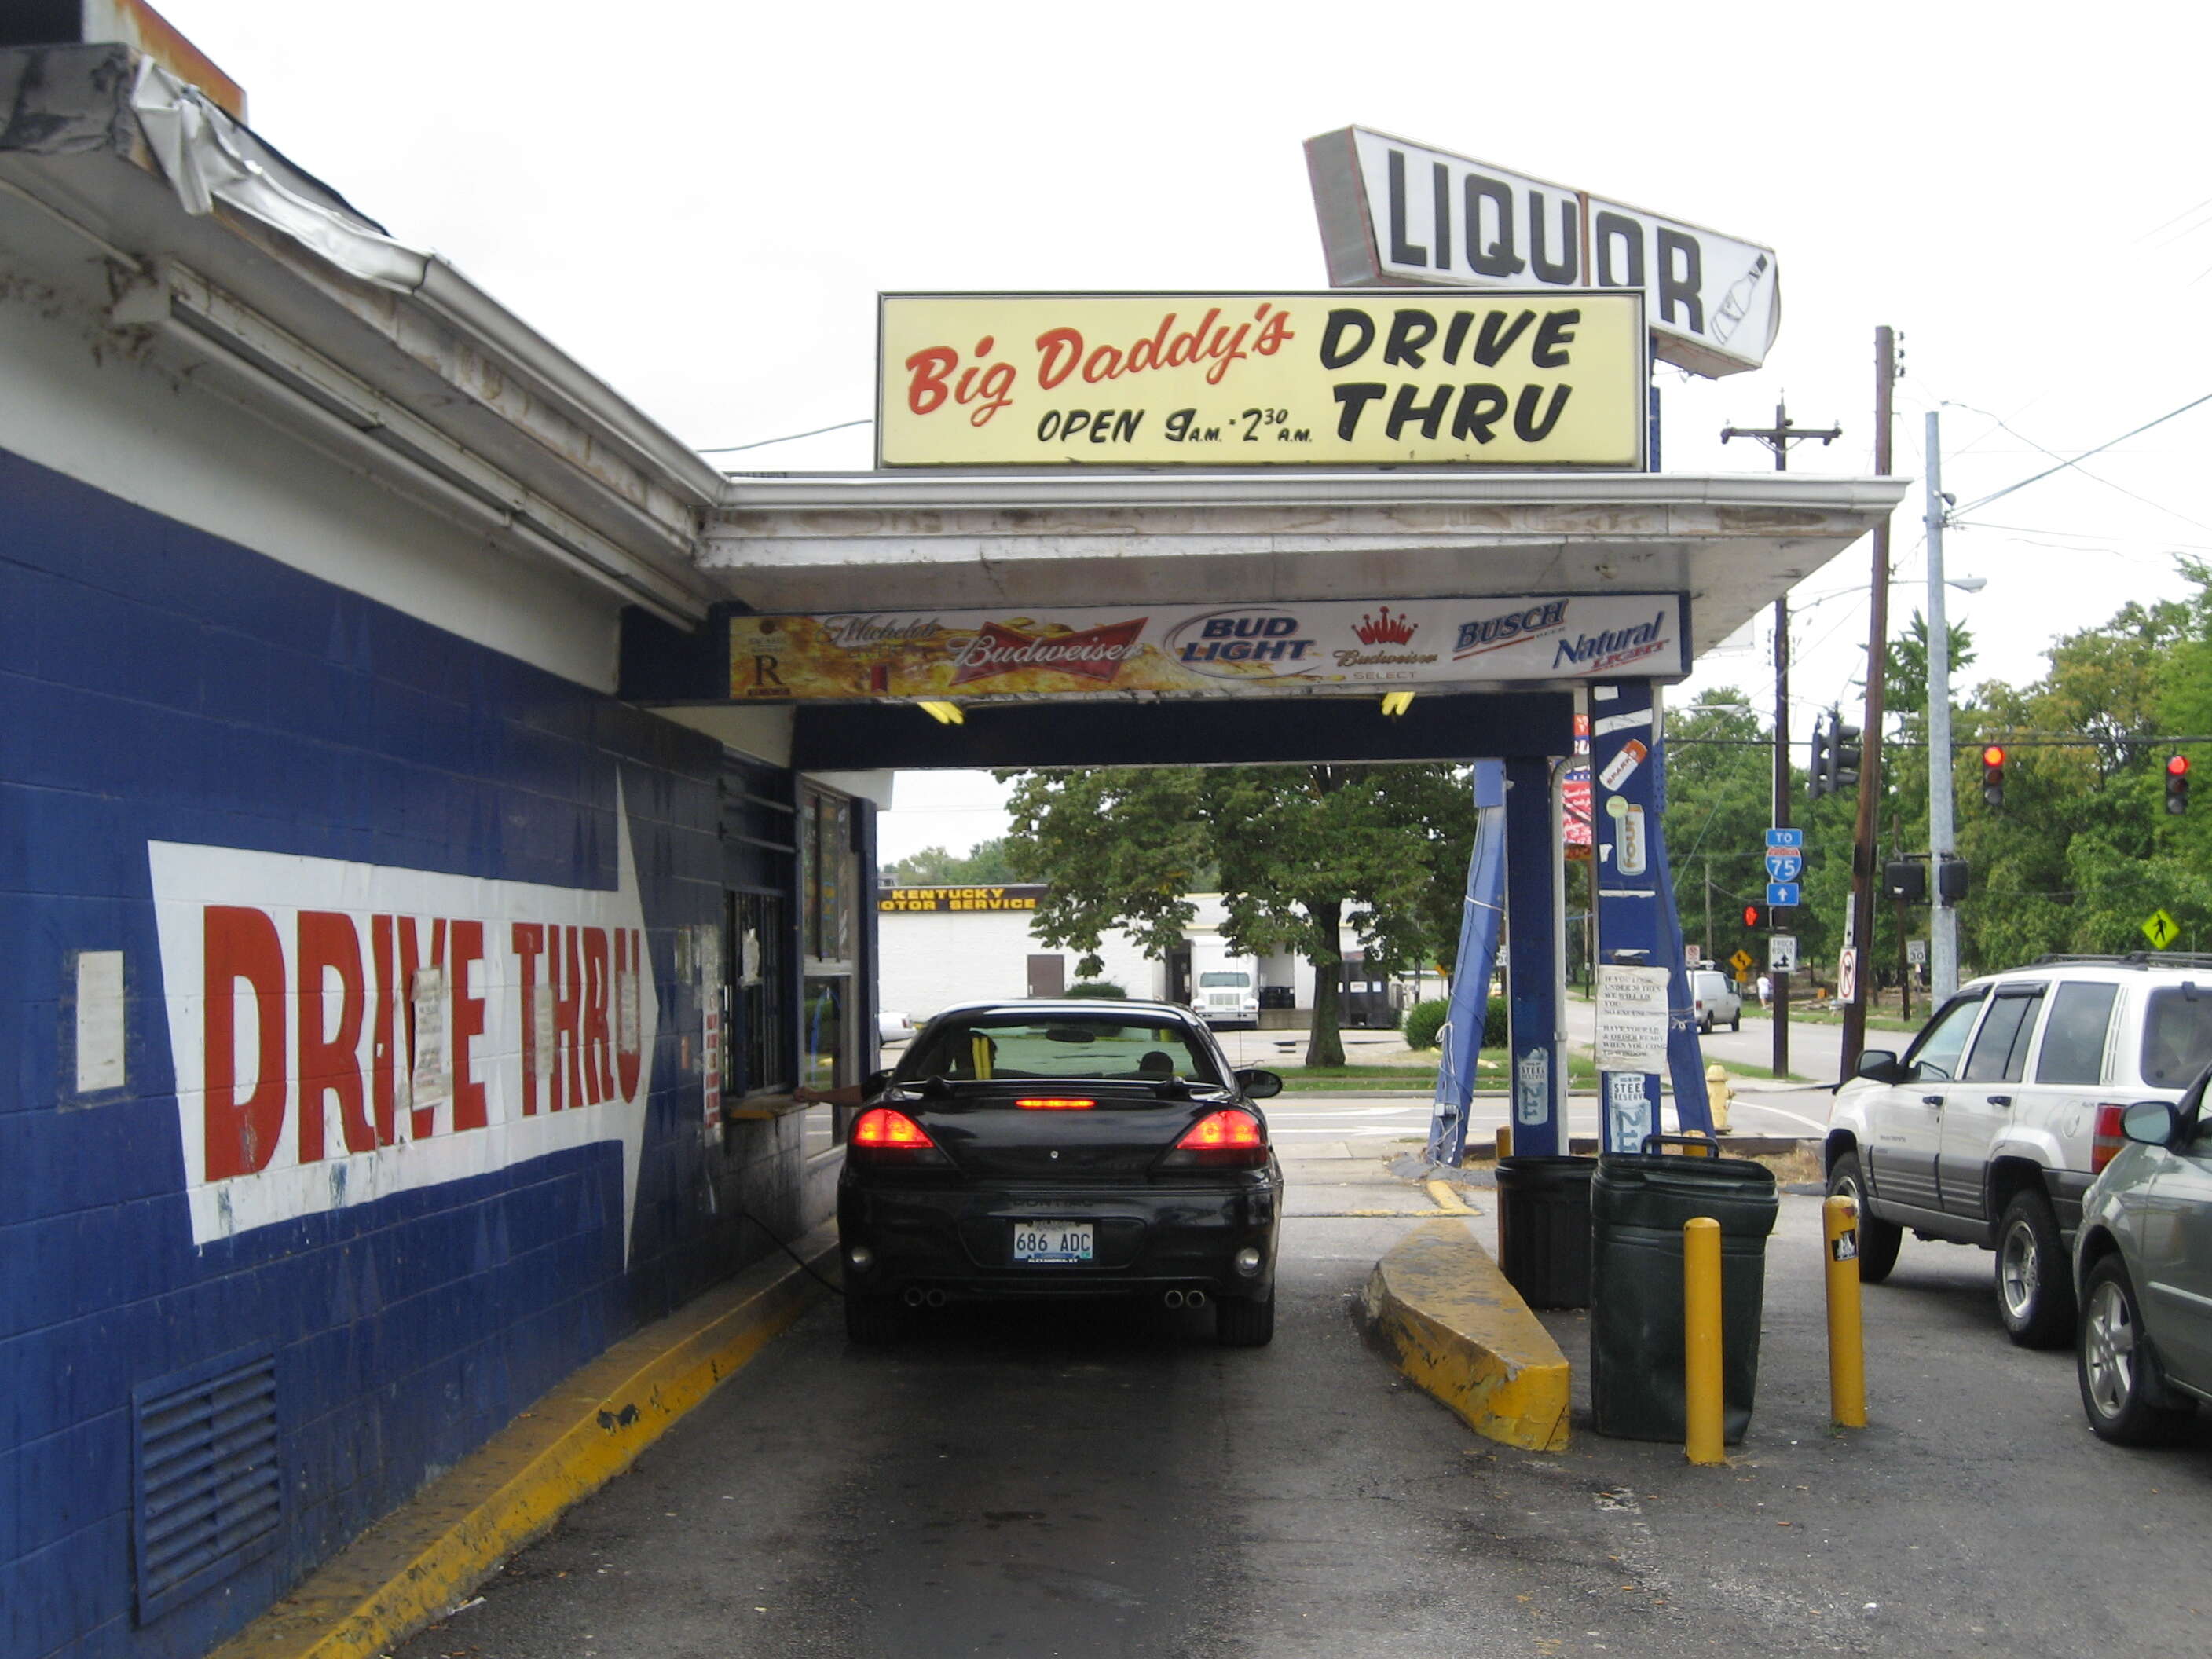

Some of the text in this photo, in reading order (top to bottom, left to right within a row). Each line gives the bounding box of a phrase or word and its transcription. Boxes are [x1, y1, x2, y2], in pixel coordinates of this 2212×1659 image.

[1388, 148, 1705, 334] LIQUOR
[1318, 308, 1580, 370] DRIVE
[906, 302, 1295, 427] Big Daddy's
[1037, 408, 1144, 443] OPEN
[1331, 383, 1572, 444] THRU
[816, 614, 941, 646] Michelob
[1201, 617, 1298, 639] BUD
[1454, 598, 1569, 652] BUSCH
[1552, 610, 1666, 669] Natural
[946, 636, 1144, 665] Budweiser
[1181, 639, 1316, 662] LIGHT
[1333, 650, 1438, 667] Budweiser
[754, 654, 785, 685] R
[1776, 833, 1793, 844] TO
[1771, 859, 1795, 877] 75
[877, 898, 1035, 910] OTOR SERVICE
[892, 888, 1005, 899] KENTUCKY
[1909, 951, 1924, 961] 30
[203, 905, 489, 1183] DRIVE
[512, 922, 640, 1117] THRU
[1016, 1233, 1090, 1251] 686 ADC
